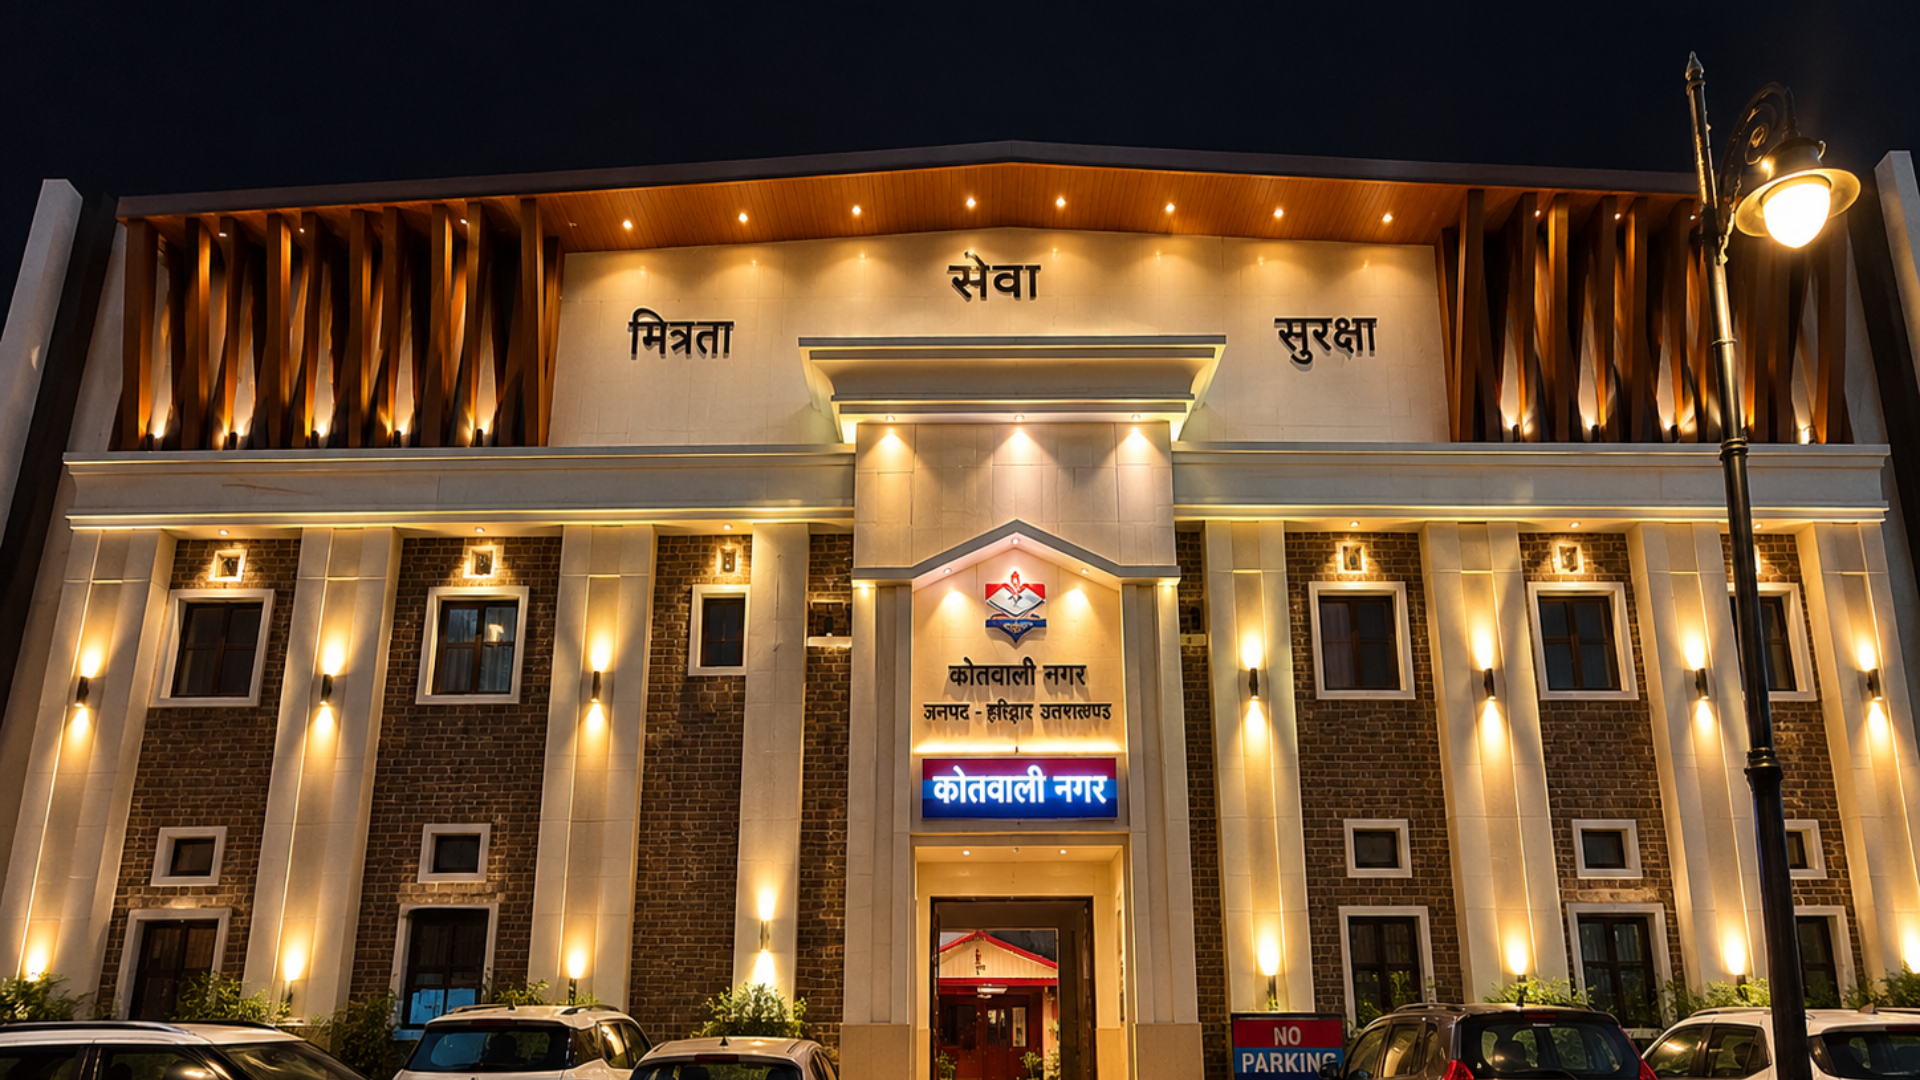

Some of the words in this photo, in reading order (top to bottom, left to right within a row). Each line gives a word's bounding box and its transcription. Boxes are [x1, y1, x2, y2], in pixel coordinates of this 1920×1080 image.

[948, 251, 1041, 299] सेवा
[628, 307, 734, 357] मित्रता
[1274, 317, 1377, 365] सुरक्षा
[948, 656, 1036, 686] कोतवाली
[1043, 665, 1087, 686] नगर
[923, 704, 970, 721] जनपद
[932, 764, 1046, 804] कोतवाली
[1053, 775, 1108, 804] नगर
[1273, 1026, 1301, 1047] NO
